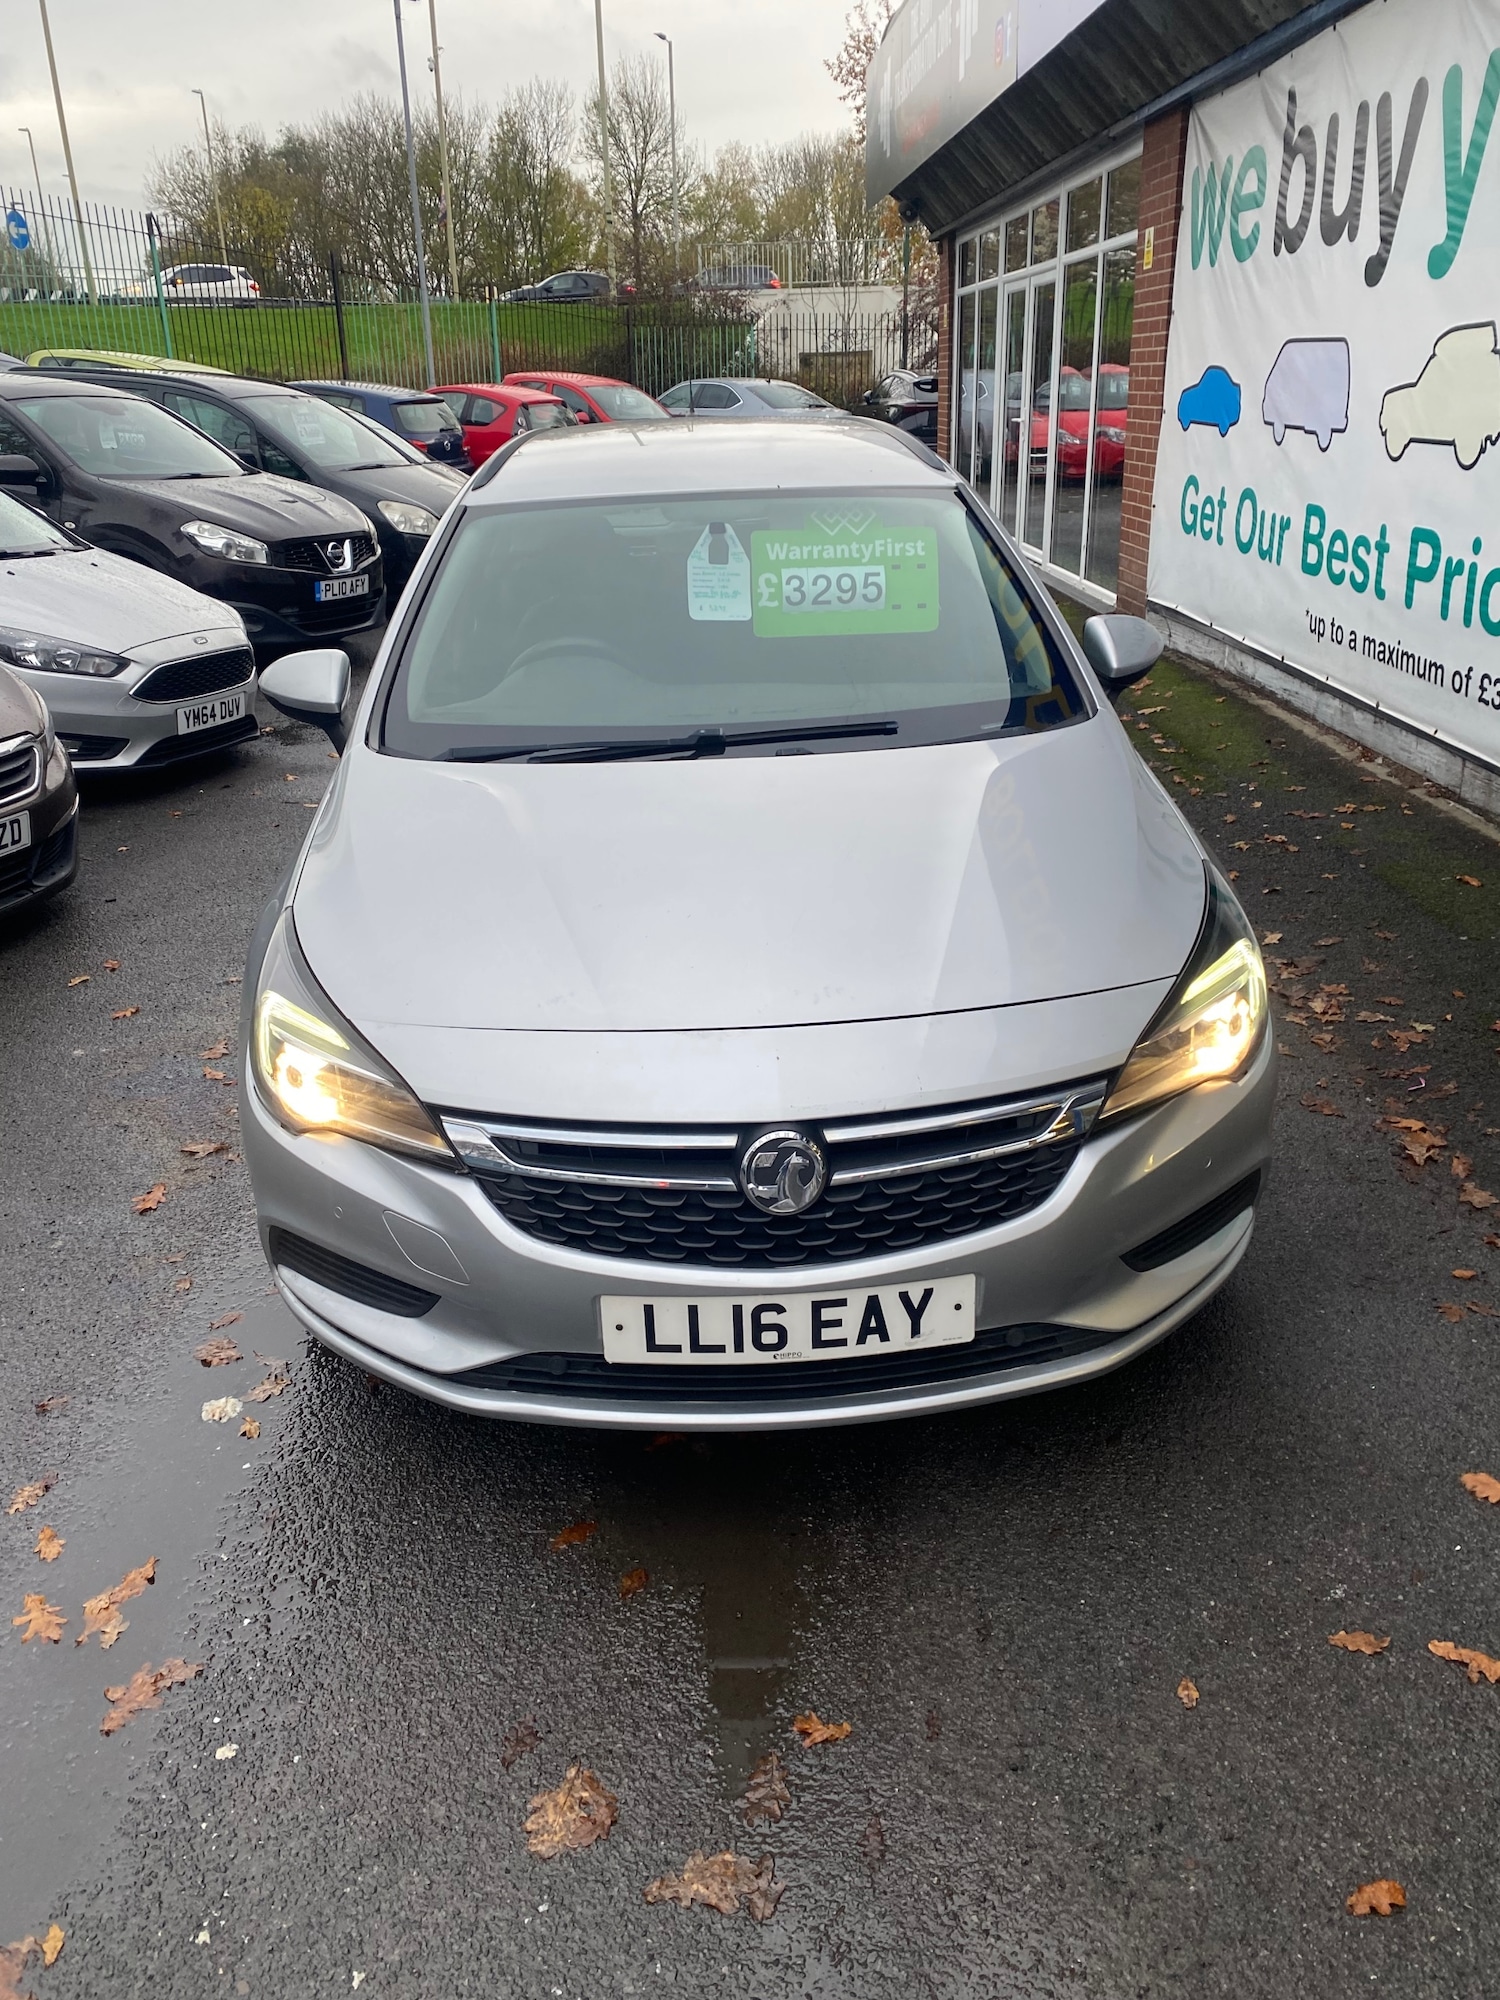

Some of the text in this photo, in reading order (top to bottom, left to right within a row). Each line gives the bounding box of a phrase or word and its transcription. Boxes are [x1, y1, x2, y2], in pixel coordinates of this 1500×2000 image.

[766, 537, 927, 563] WarrantyFirst
[1181, 475, 1227, 546] Get
[1235, 487, 1291, 566] Our
[1301, 503, 1390, 601] Best
[349, 577, 366, 595] AFY
[1331, 617, 1344, 645] to
[1348, 630, 1357, 652] a
[1362, 633, 1445, 688] maximum
[1451, 666, 1474, 698] of
[184, 696, 241, 729] YM64 DUV
[643, 1287, 934, 1353] LL16 EAY
